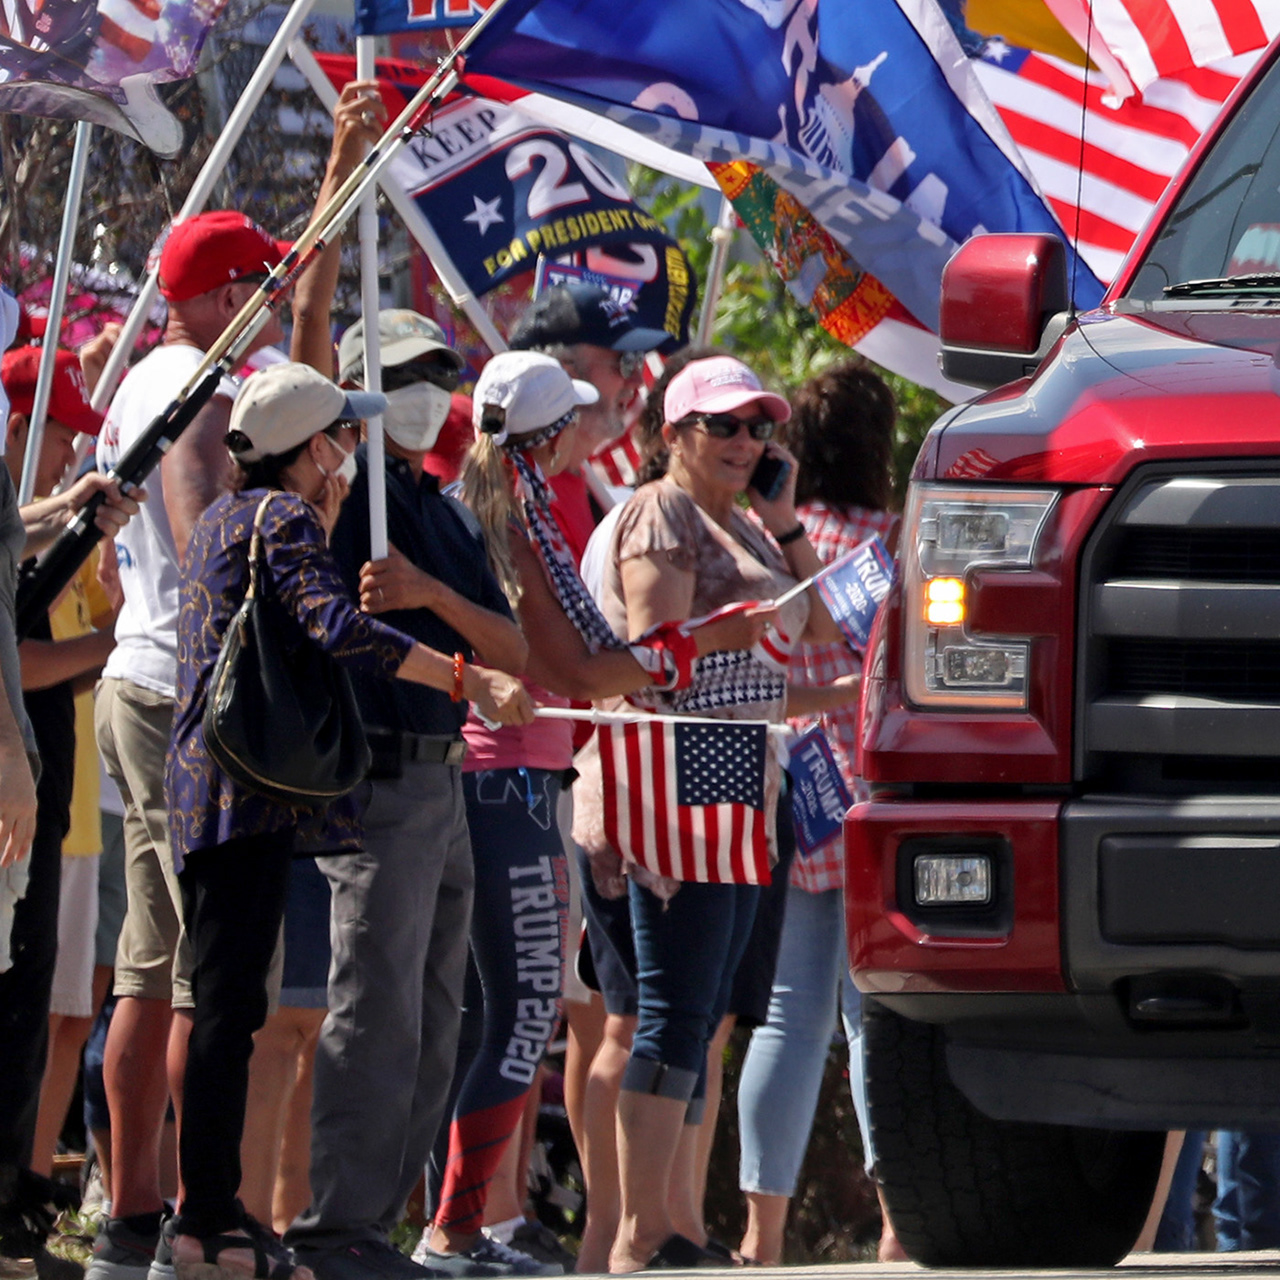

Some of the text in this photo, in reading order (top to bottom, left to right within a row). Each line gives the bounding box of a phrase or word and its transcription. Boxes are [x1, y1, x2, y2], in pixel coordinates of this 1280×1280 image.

[411, 108, 499, 169] KEEP
[482, 237, 529, 279] FOR
[525, 208, 635, 254] PRESIDENT
[852, 546, 892, 604] TRUM
[801, 740, 847, 824] TRUMP
[508, 854, 561, 993] TRUMP
[499, 997, 557, 1086] 2020
